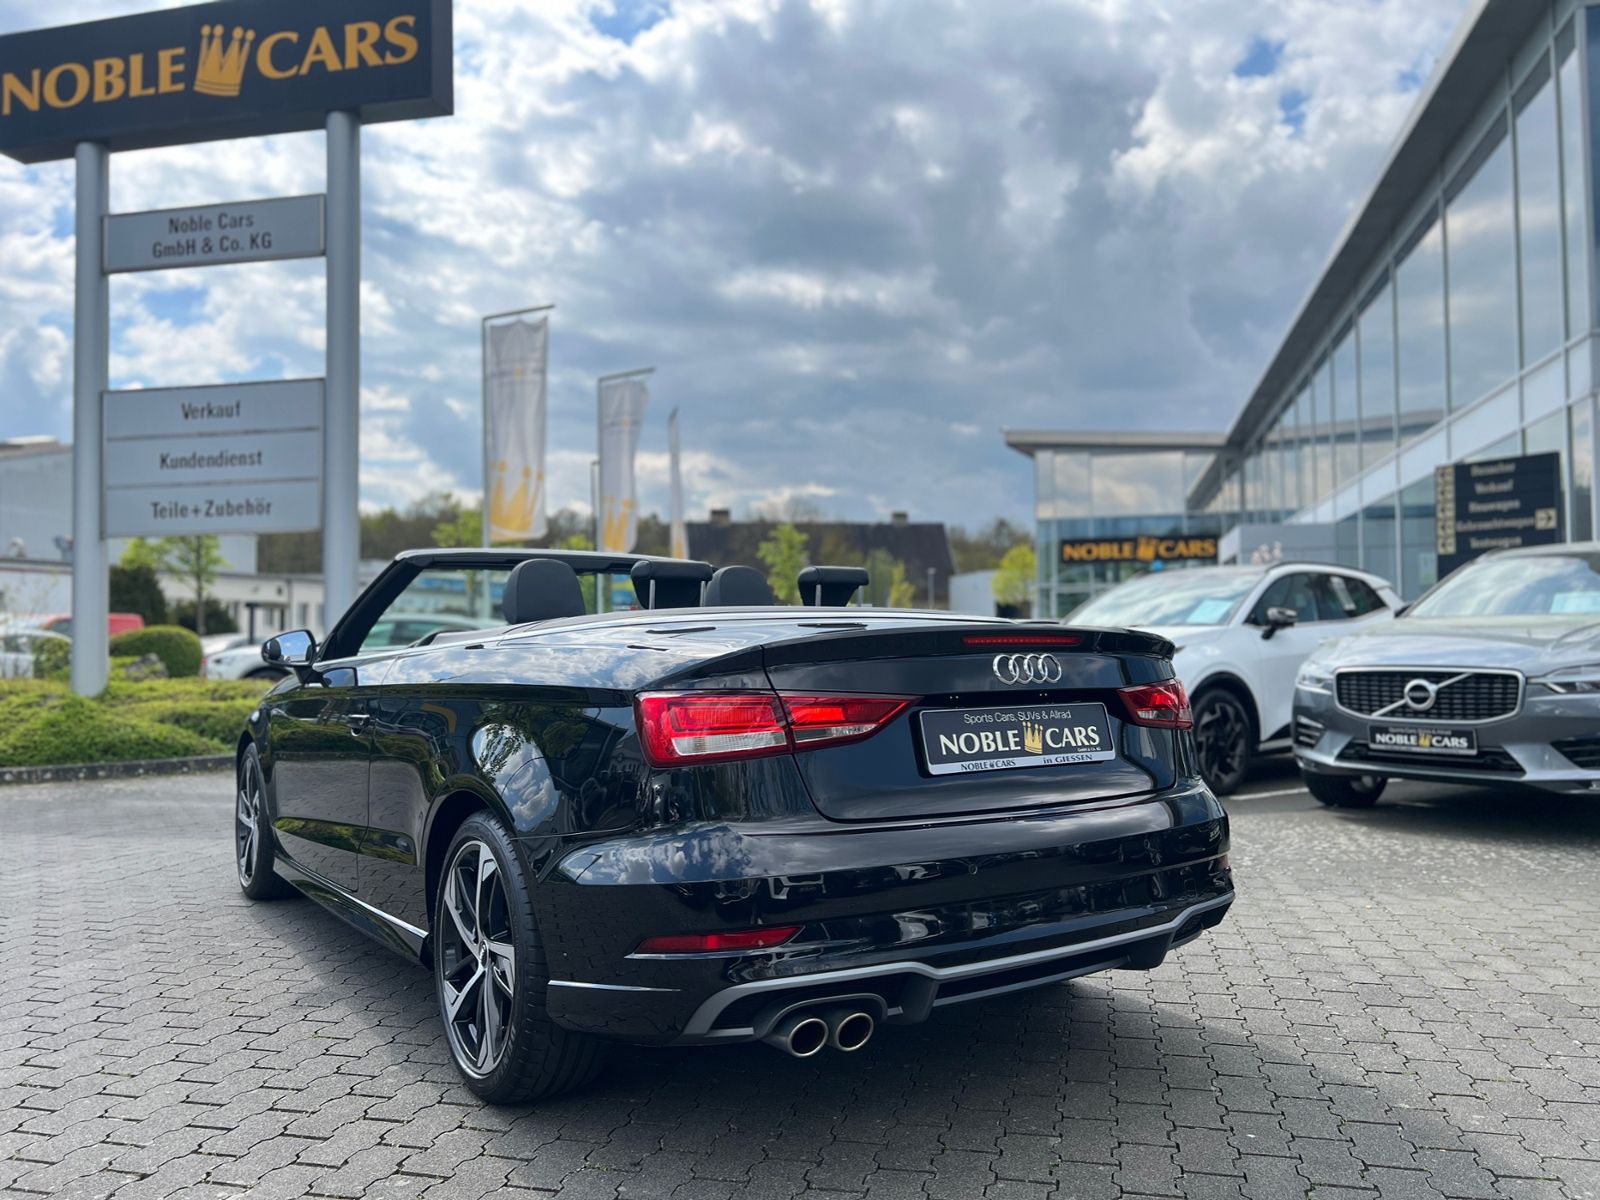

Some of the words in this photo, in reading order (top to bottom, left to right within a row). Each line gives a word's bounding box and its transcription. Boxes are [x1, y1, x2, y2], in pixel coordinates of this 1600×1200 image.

[2, 47, 186, 115] NOBLE
[256, 15, 419, 79] CARS
[168, 215, 213, 234] Noble
[218, 212, 254, 230] Cars
[152, 239, 196, 259] GmbH
[201, 238, 213, 255] &
[219, 235, 244, 253] Co.
[250, 232, 272, 250] KG
[181, 400, 241, 420] Verkauf
[160, 451, 263, 470] Kundendienst
[1062, 541, 1135, 561] NOBLE
[1158, 538, 1216, 558] CARS
[963, 713, 994, 725] Sports
[994, 711, 1018, 722] Cars,
[1017, 711, 1041, 721] SUVs
[1041, 710, 1049, 720] &
[1049, 709, 1072, 719] Allrad
[939, 729, 1021, 756] NOBLE
[1045, 726, 1100, 747] CARS
[1375, 733, 1417, 744] NOBLE
[1432, 736, 1468, 748] CARS
[960, 761, 988, 771] NOBLE
[995, 759, 1017, 768] CARS
[1043, 757, 1053, 765] in
[1055, 753, 1093, 763] GIESSEN
